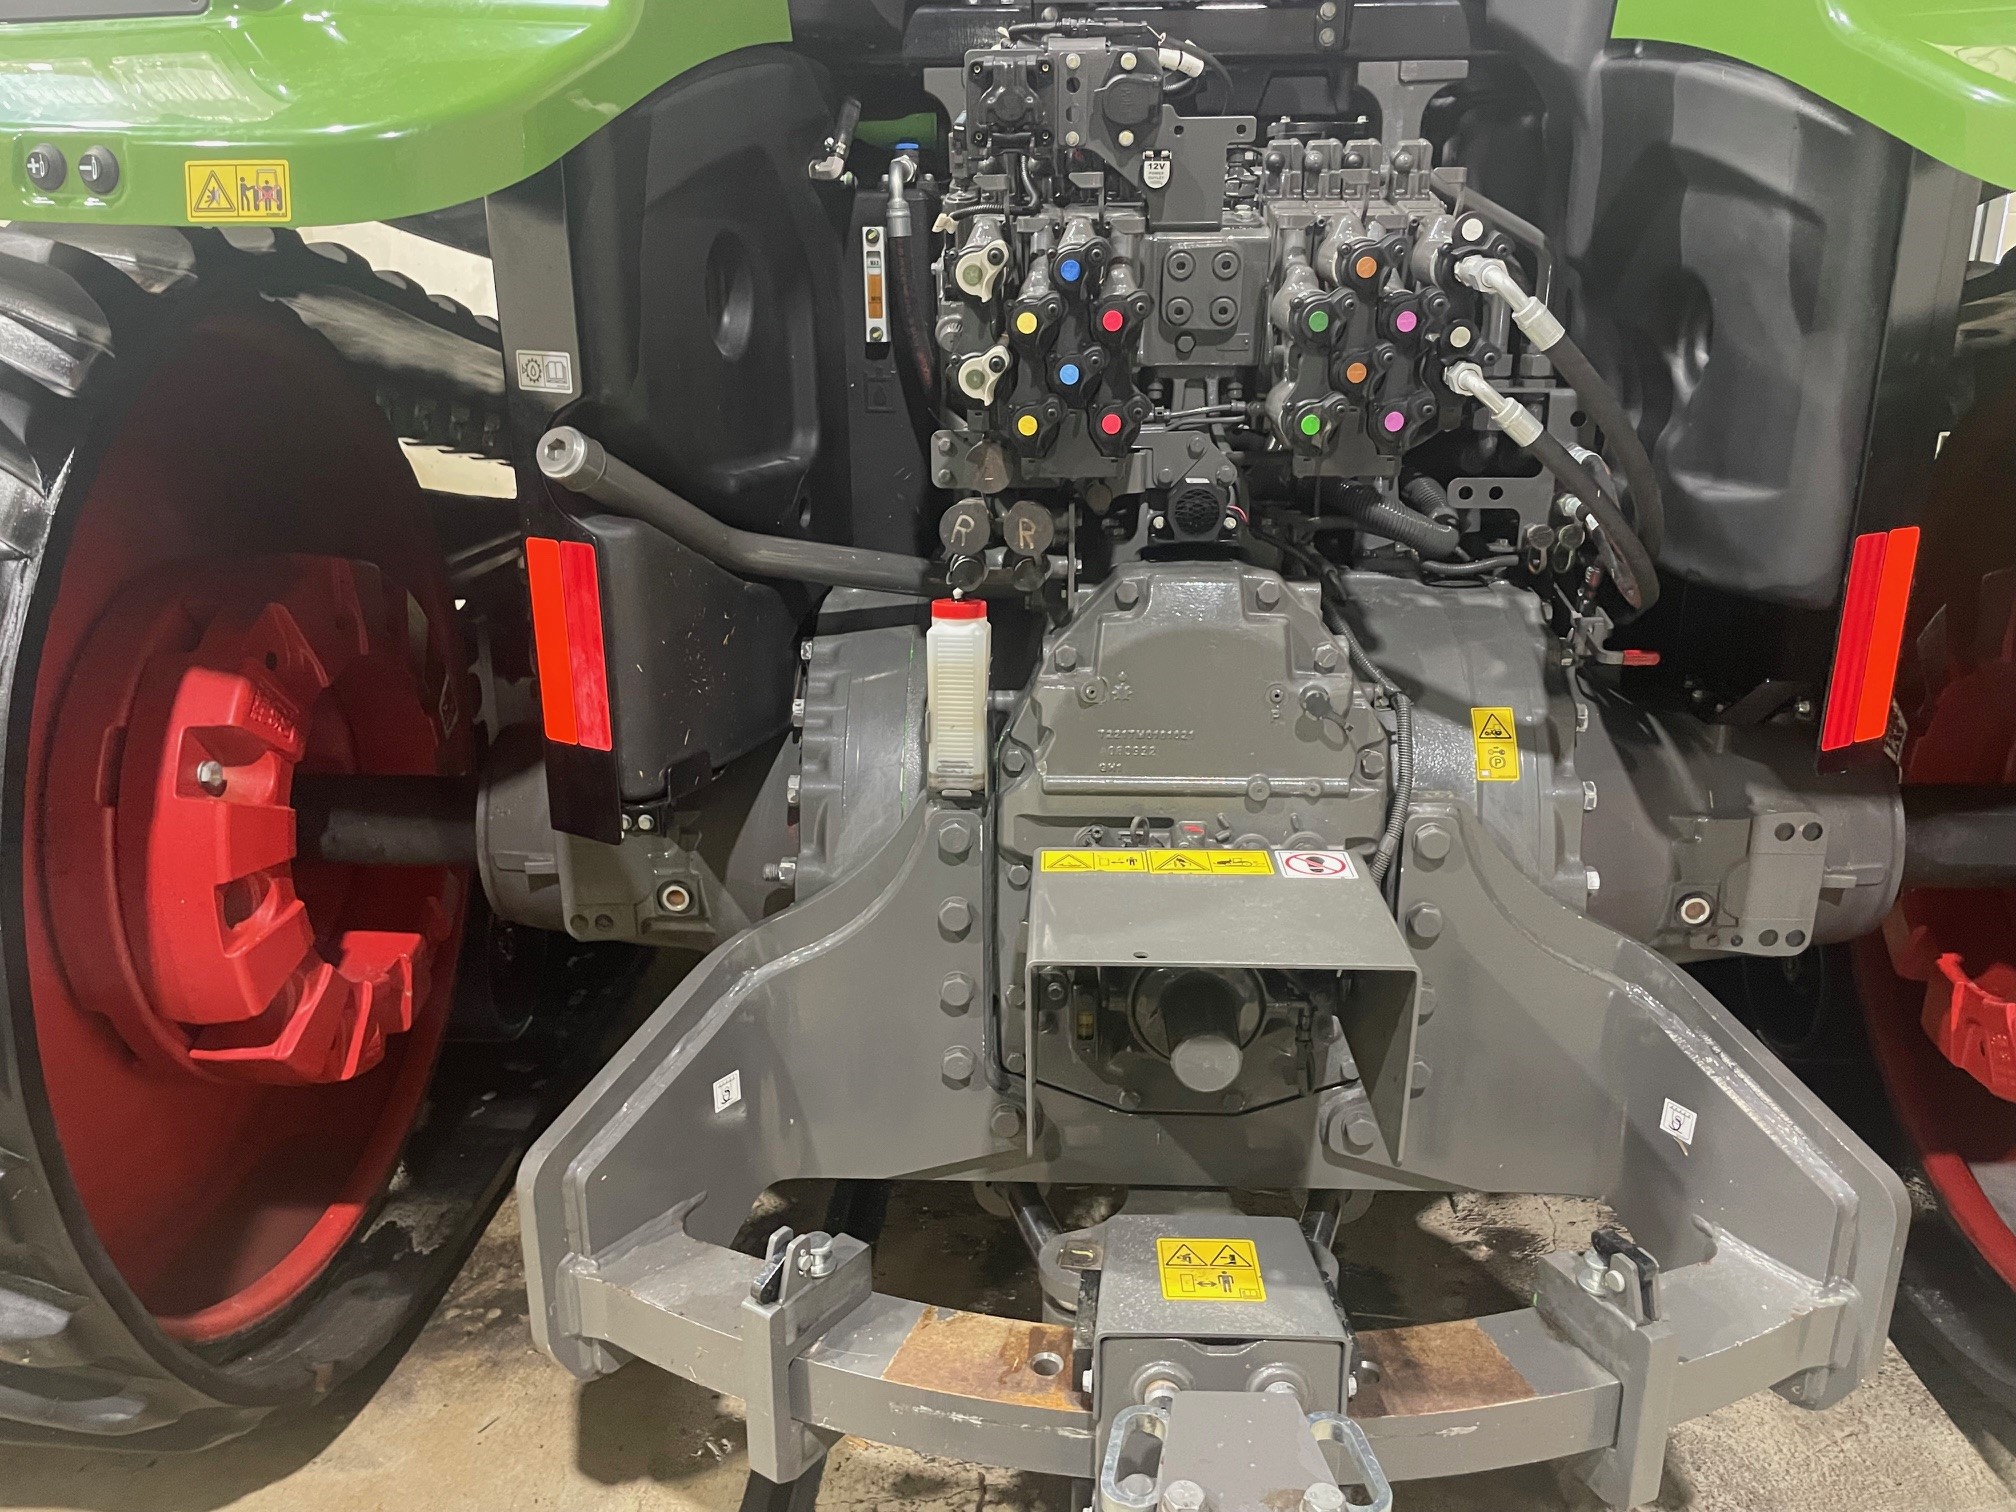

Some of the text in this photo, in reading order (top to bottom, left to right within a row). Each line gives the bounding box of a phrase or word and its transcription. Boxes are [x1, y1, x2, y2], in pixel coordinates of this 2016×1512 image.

[1148, 162, 1166, 170] 12V
[950, 514, 975, 546] R
[1018, 518, 1037, 549] R
